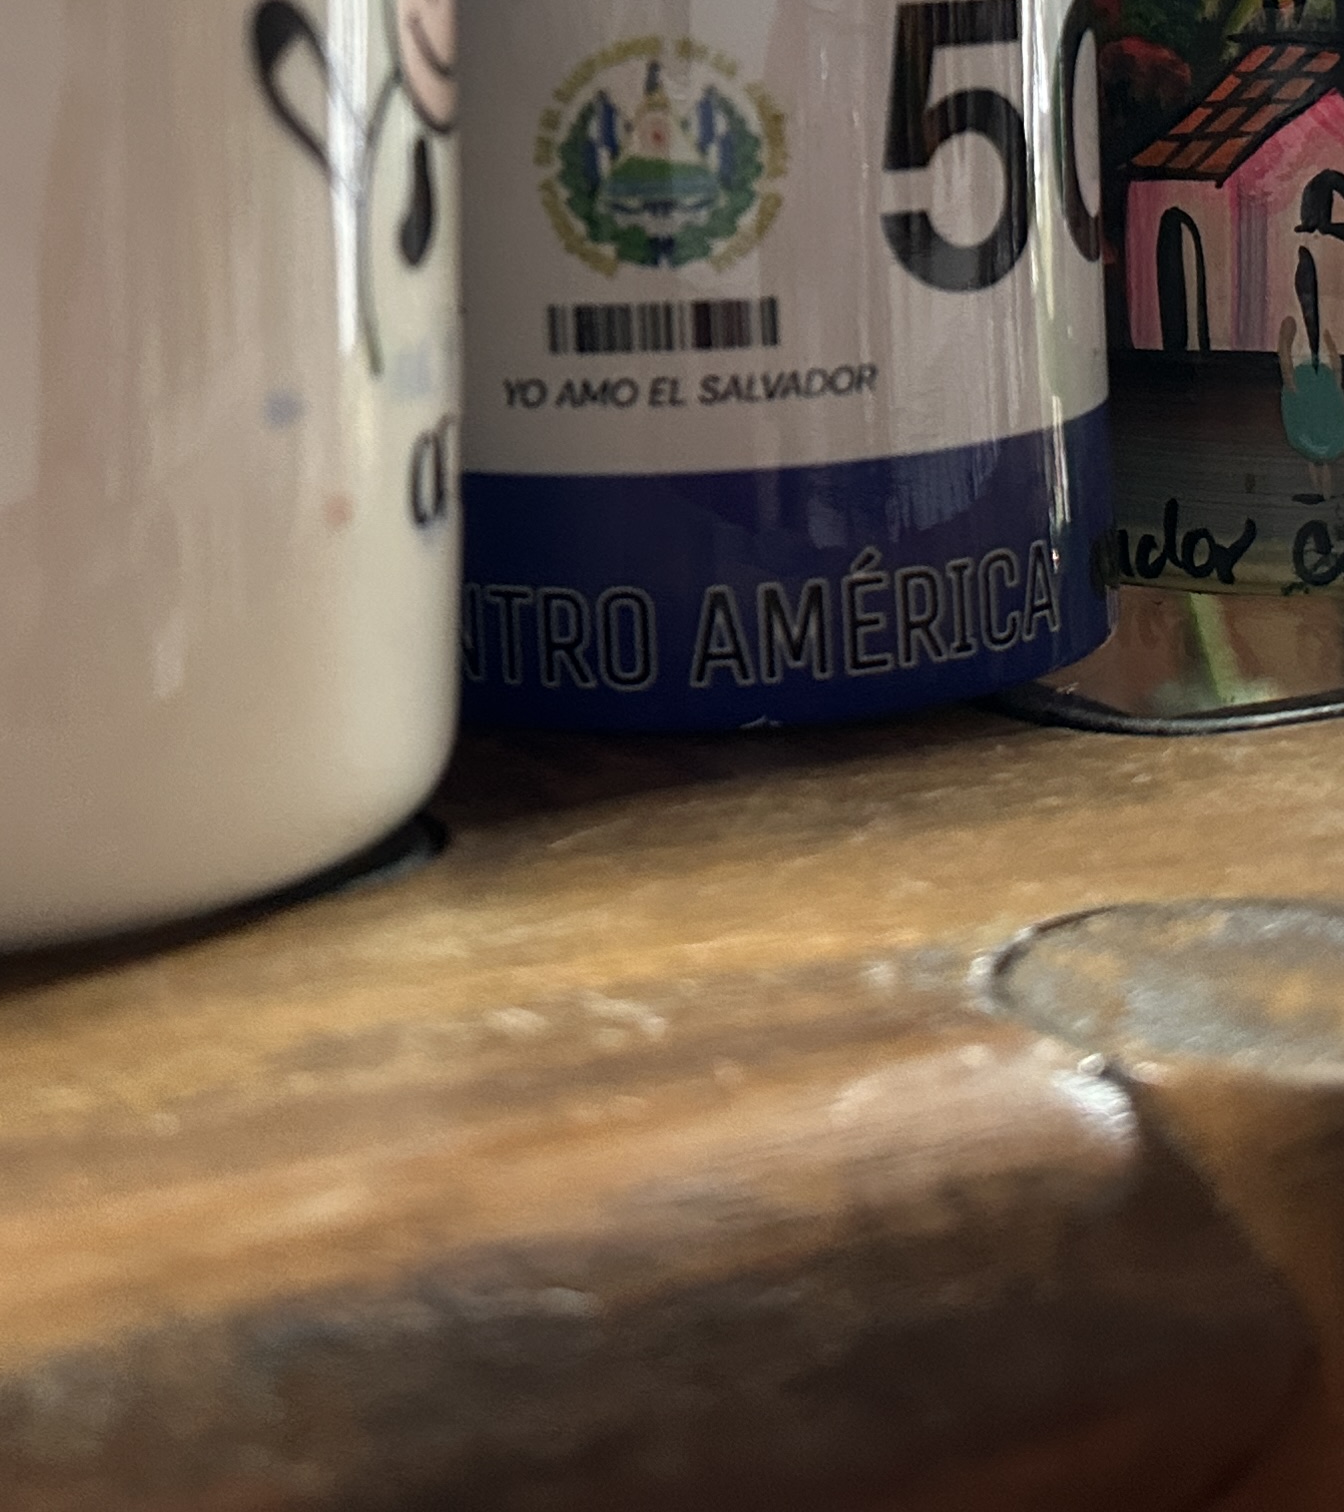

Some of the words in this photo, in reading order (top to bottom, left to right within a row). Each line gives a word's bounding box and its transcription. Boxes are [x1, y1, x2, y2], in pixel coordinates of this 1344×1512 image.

[503, 375, 548, 409] YO
[556, 376, 640, 409] AMO
[647, 376, 686, 407] EL
[698, 362, 879, 405] SALVADOR
[689, 538, 1061, 689] AMÉRICA
